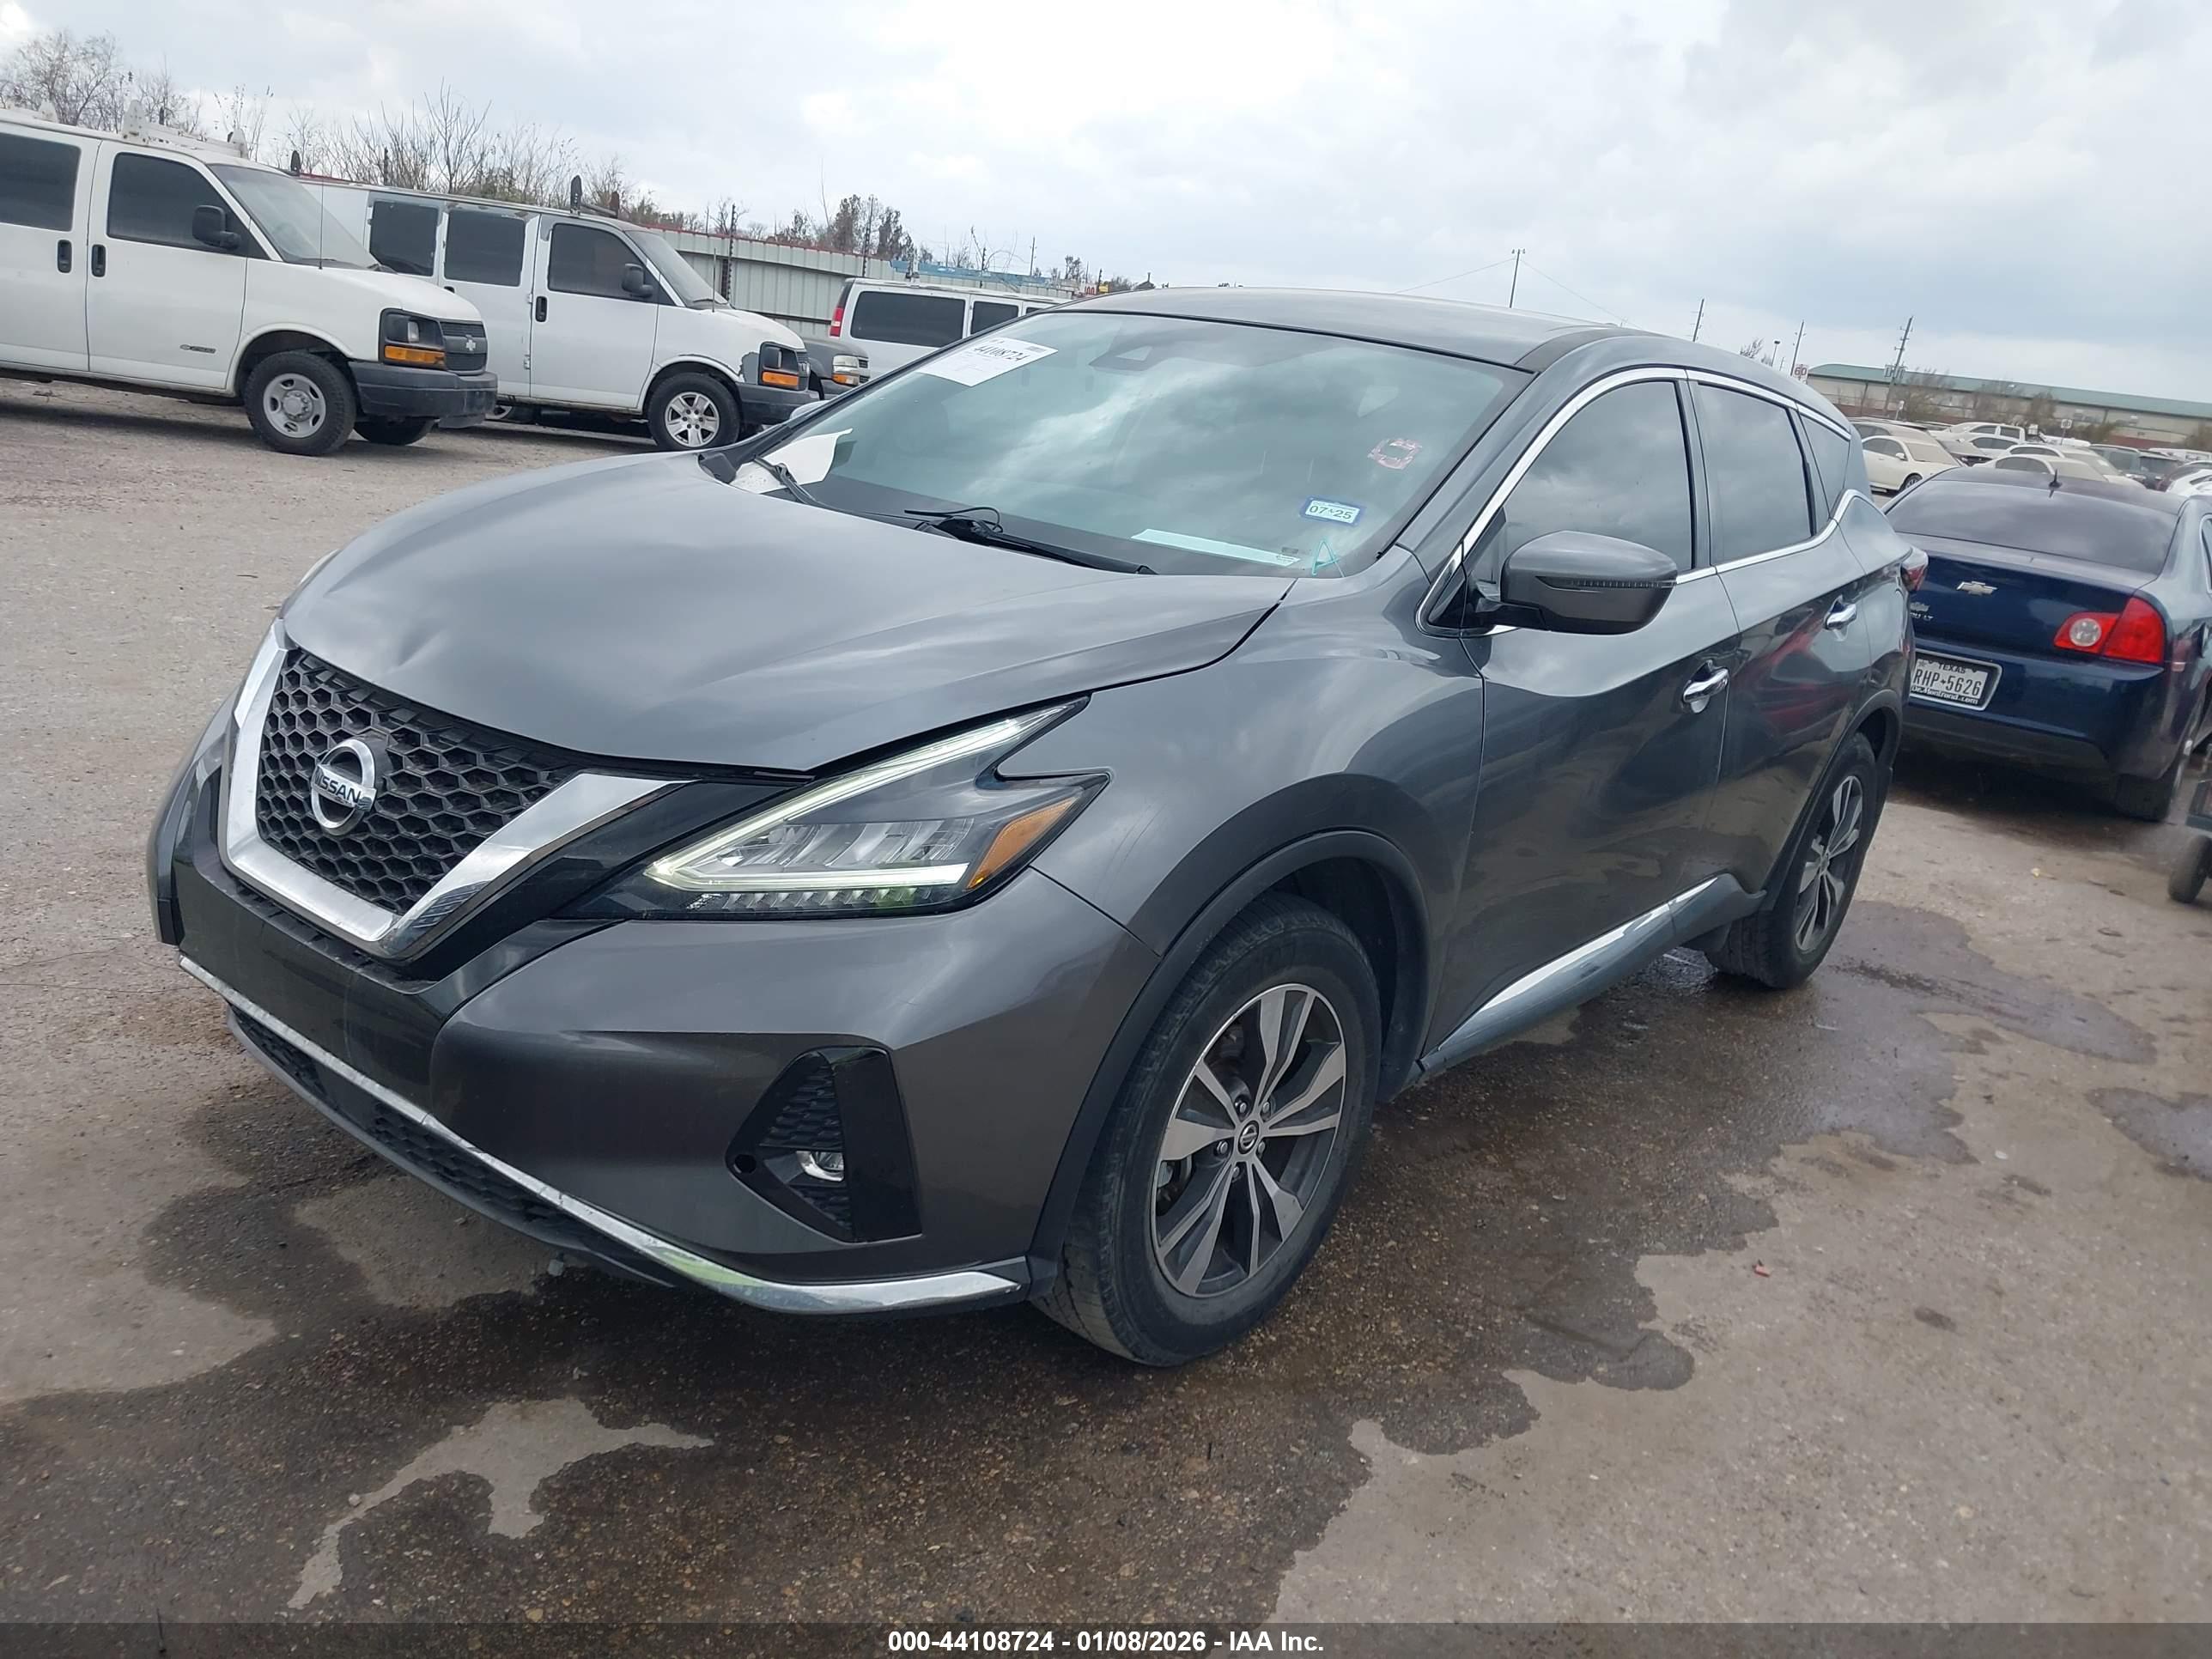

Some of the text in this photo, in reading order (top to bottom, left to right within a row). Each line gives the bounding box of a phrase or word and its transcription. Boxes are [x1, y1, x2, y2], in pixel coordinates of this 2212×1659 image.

[1794, 367, 1808, 376] 60
[1938, 663, 1966, 674] TEXAS
[314, 767, 362, 805] NISSAN
